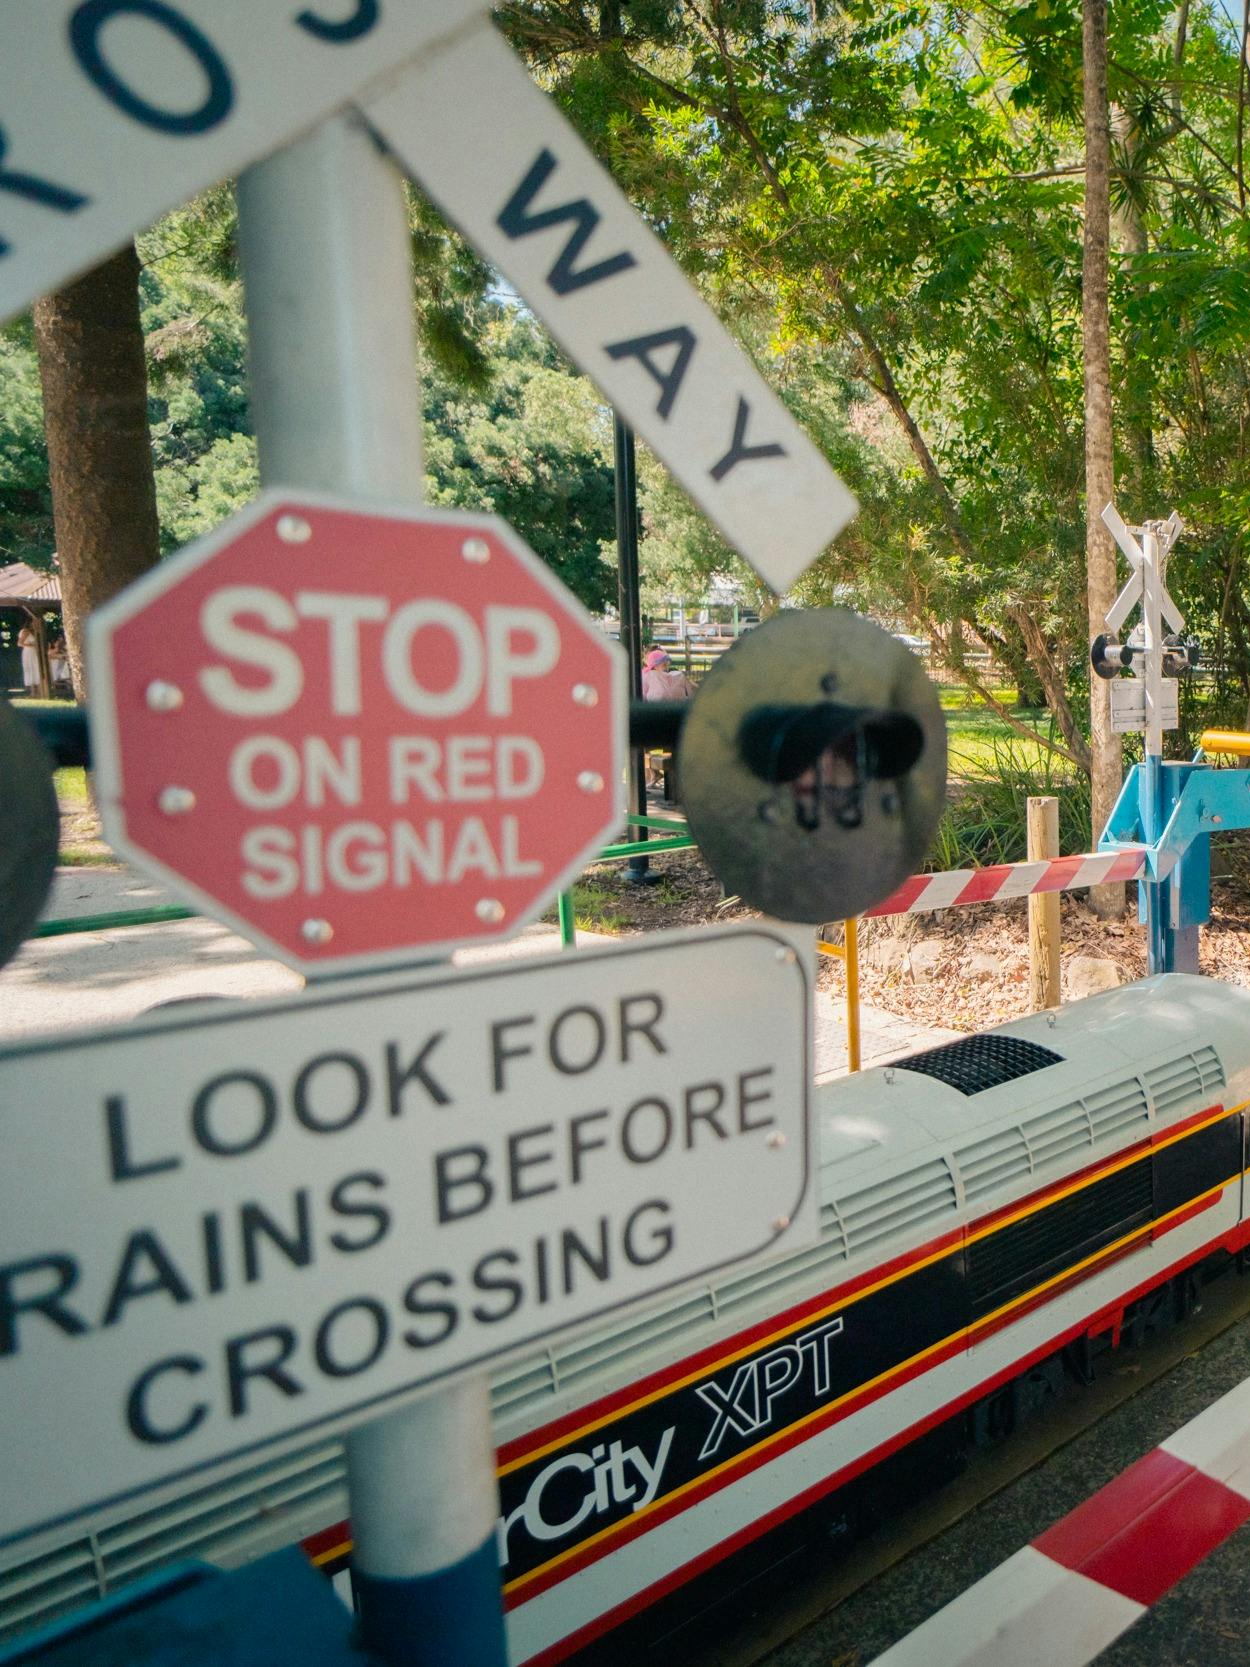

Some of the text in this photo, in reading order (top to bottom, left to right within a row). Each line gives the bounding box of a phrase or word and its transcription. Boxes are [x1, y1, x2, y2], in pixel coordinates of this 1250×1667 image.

[497, 150, 783, 482] WAY
[200, 585, 560, 719] STOP
[229, 735, 545, 811] ON RED
[241, 815, 543, 899] SIGNAL
[104, 992, 666, 1183] LOOK FOR
[434, 1067, 774, 1225] BEFORE
[124, 1200, 674, 1448] CROSSING
[499, 1316, 844, 1566] rCity XPT
